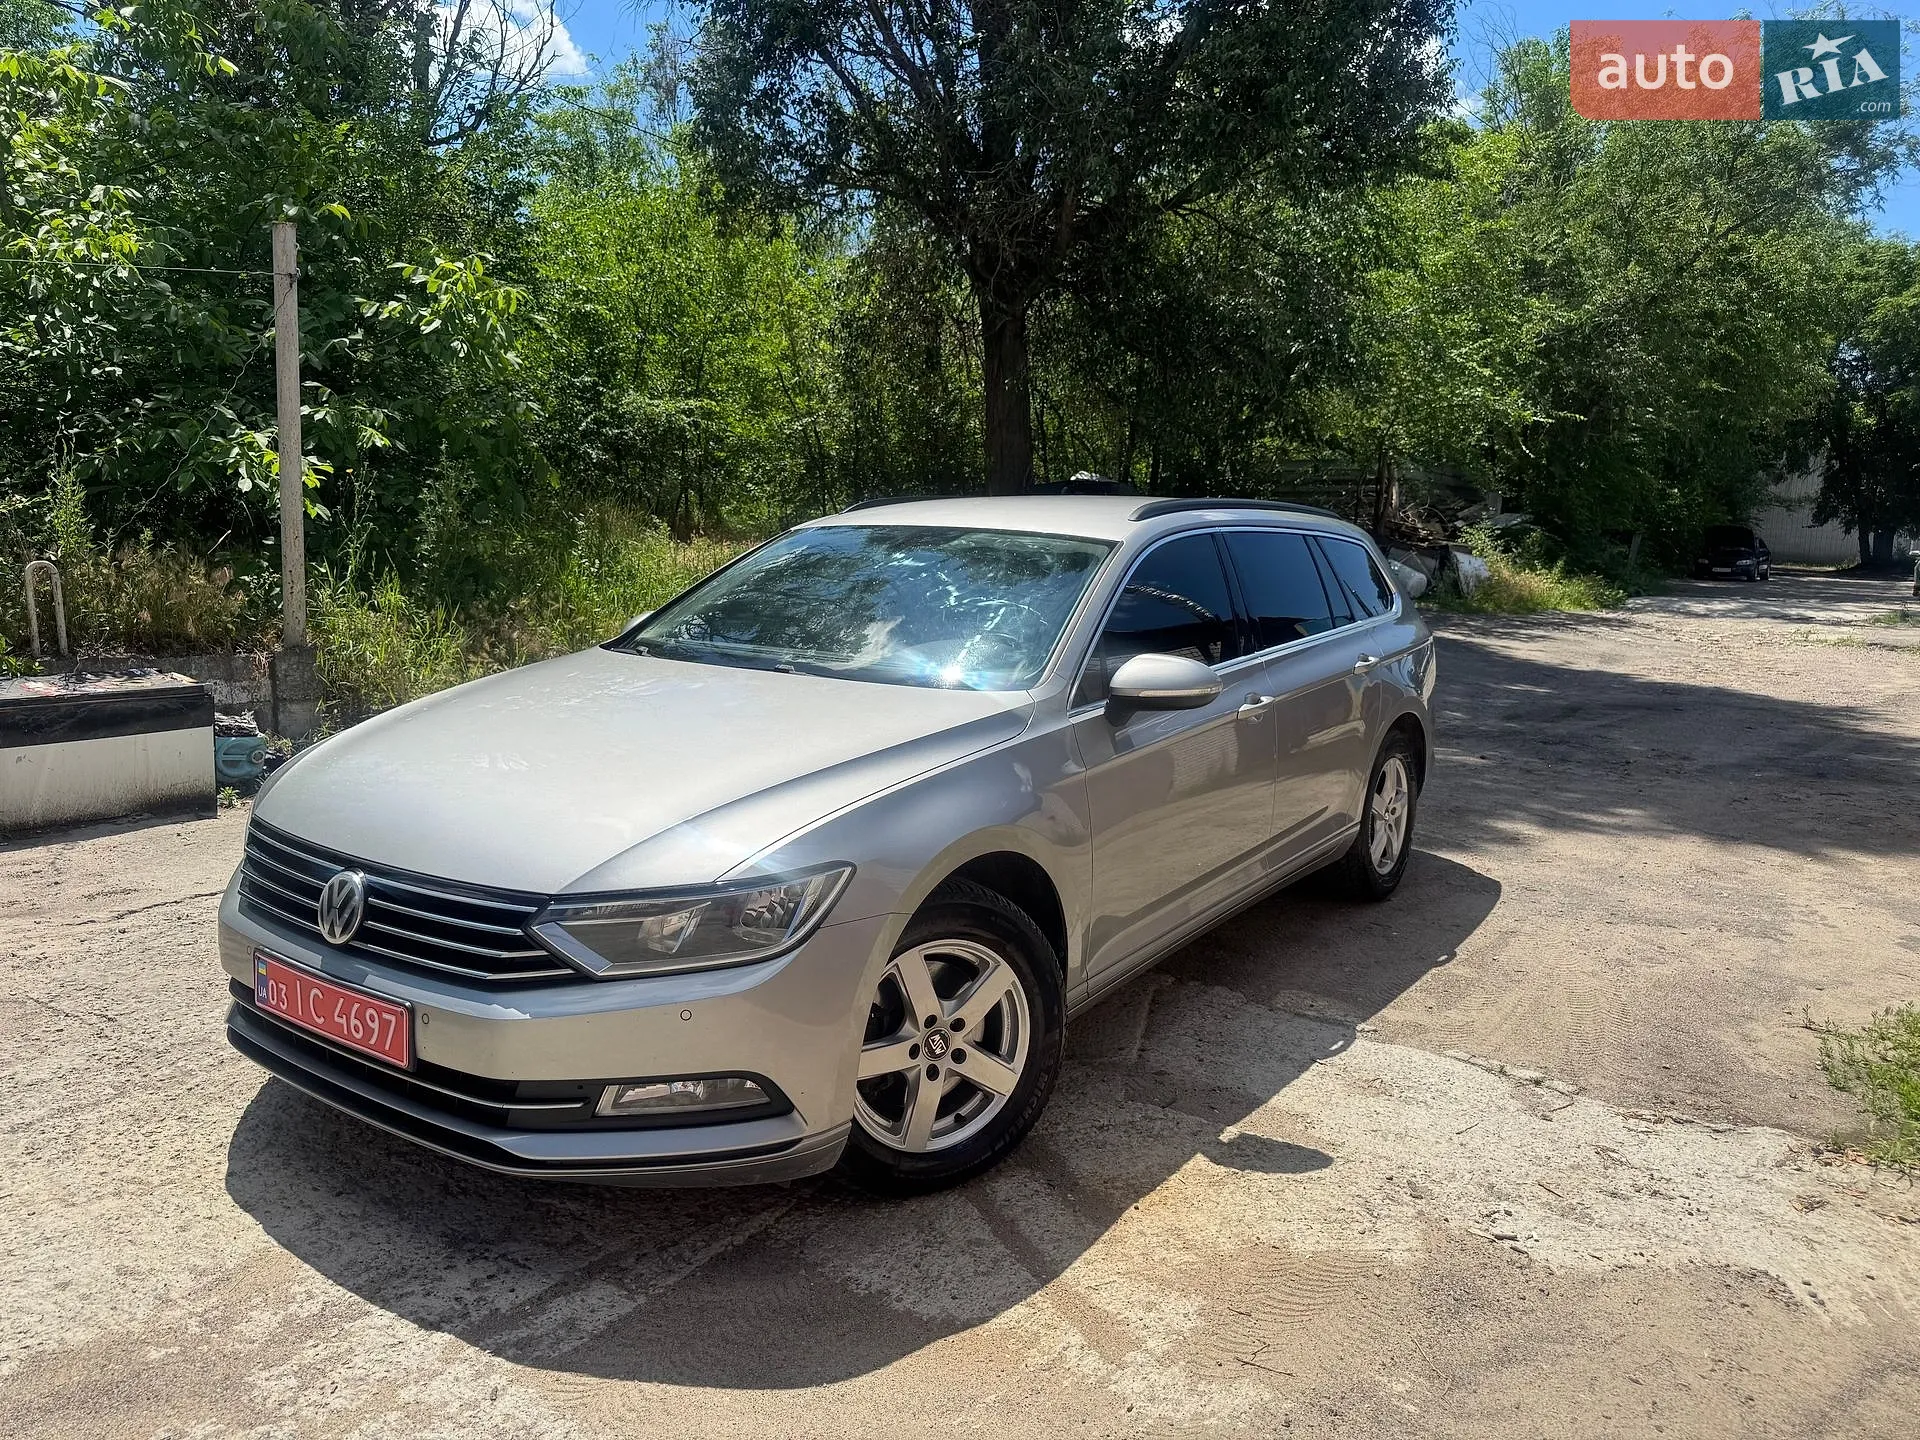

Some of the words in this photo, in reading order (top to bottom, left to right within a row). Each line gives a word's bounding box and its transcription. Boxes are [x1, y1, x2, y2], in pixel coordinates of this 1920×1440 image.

[258, 986, 268, 999] UA
[268, 979, 288, 1010] 03
[334, 997, 397, 1051] 4697
